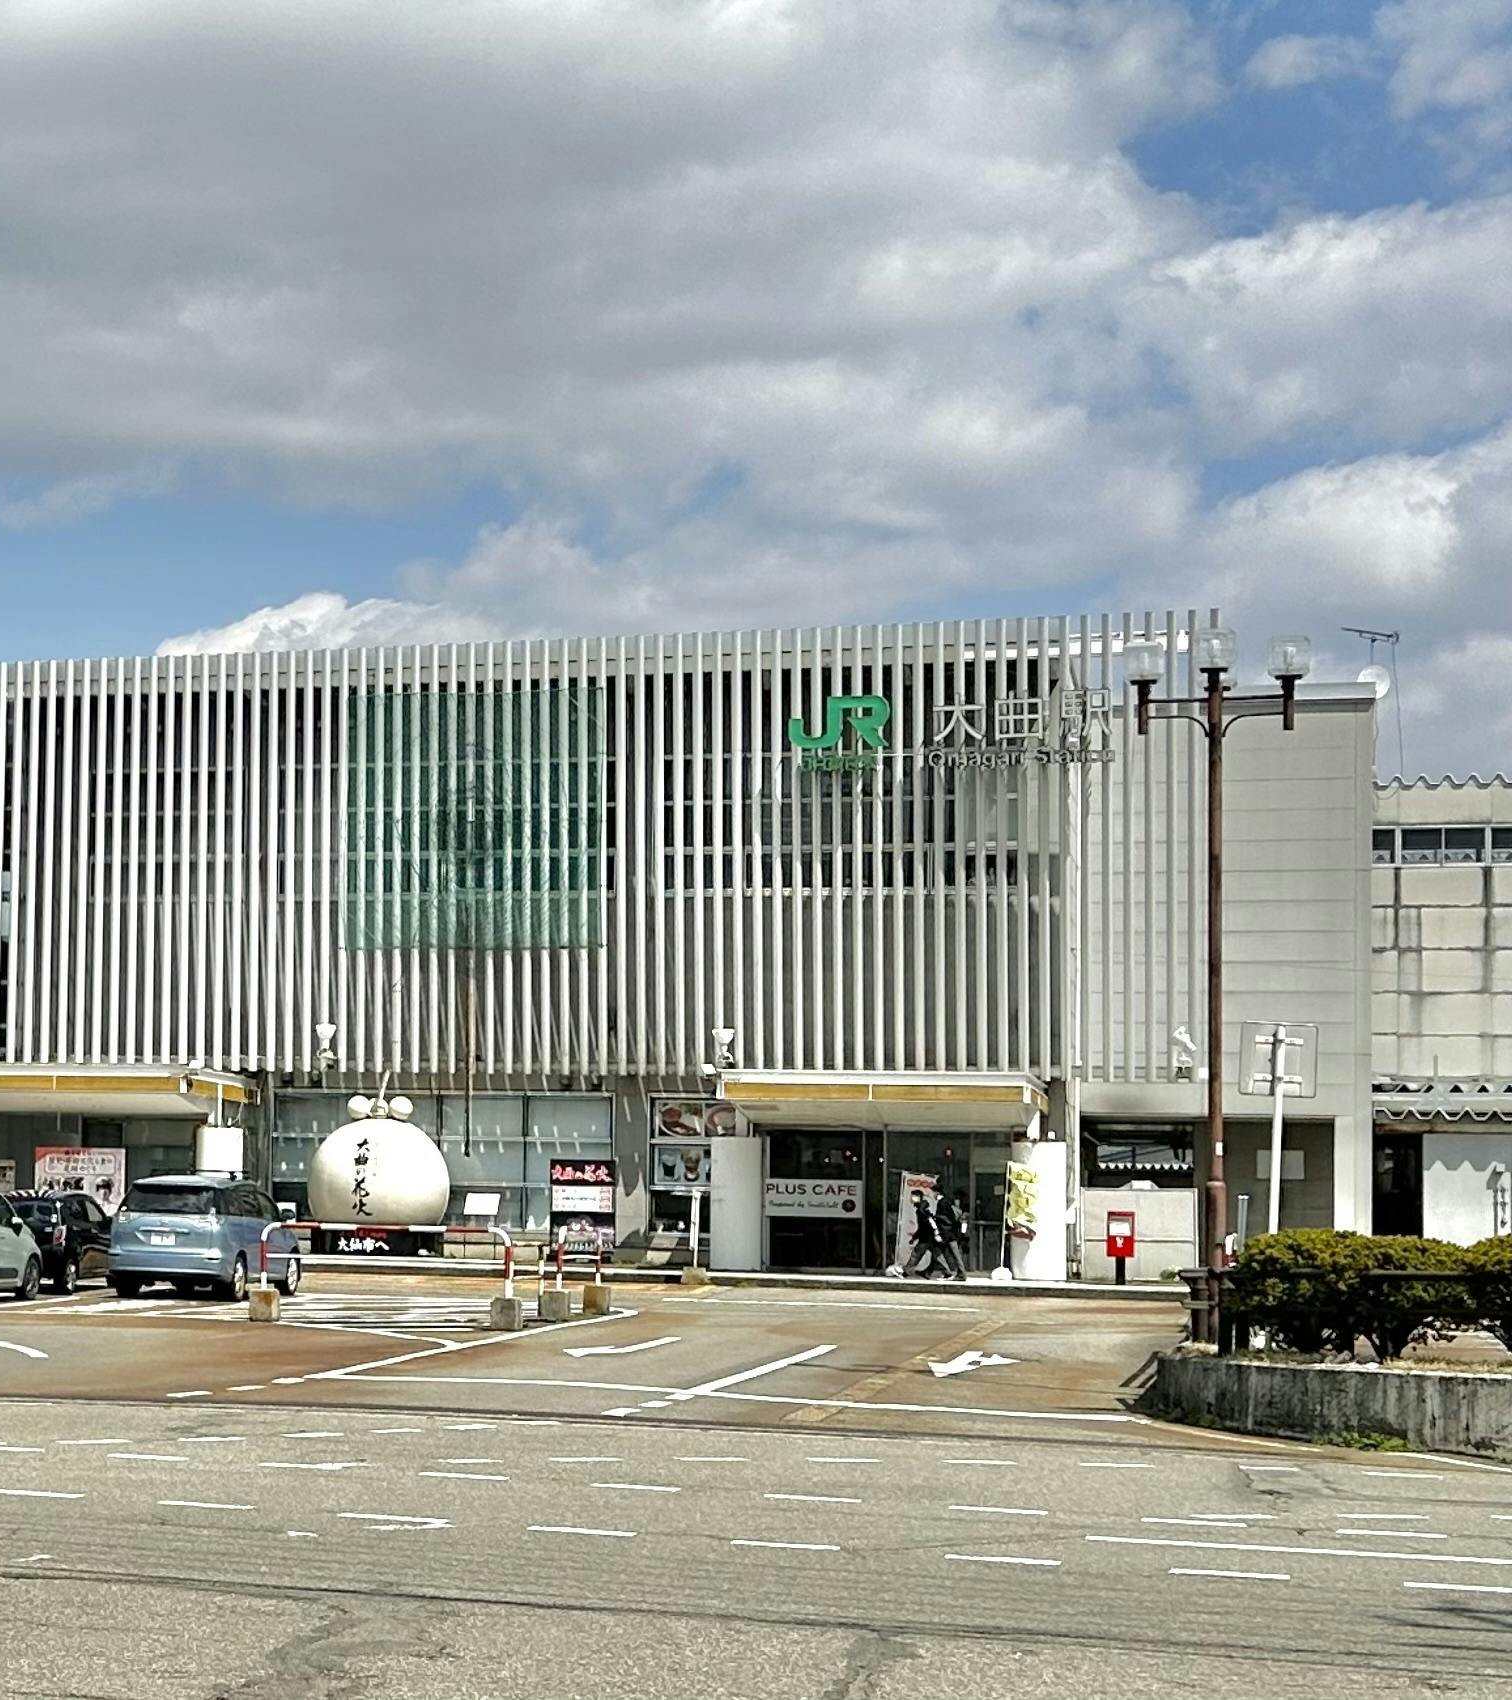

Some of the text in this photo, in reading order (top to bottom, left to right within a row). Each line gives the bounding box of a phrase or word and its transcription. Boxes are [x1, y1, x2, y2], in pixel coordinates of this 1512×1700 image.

[788, 695, 890, 748] JR
[932, 688, 1113, 748] 大曲駅
[351, 1138, 373, 1216] 大曲の花火
[766, 1183, 857, 1196] PLUS CAFE
